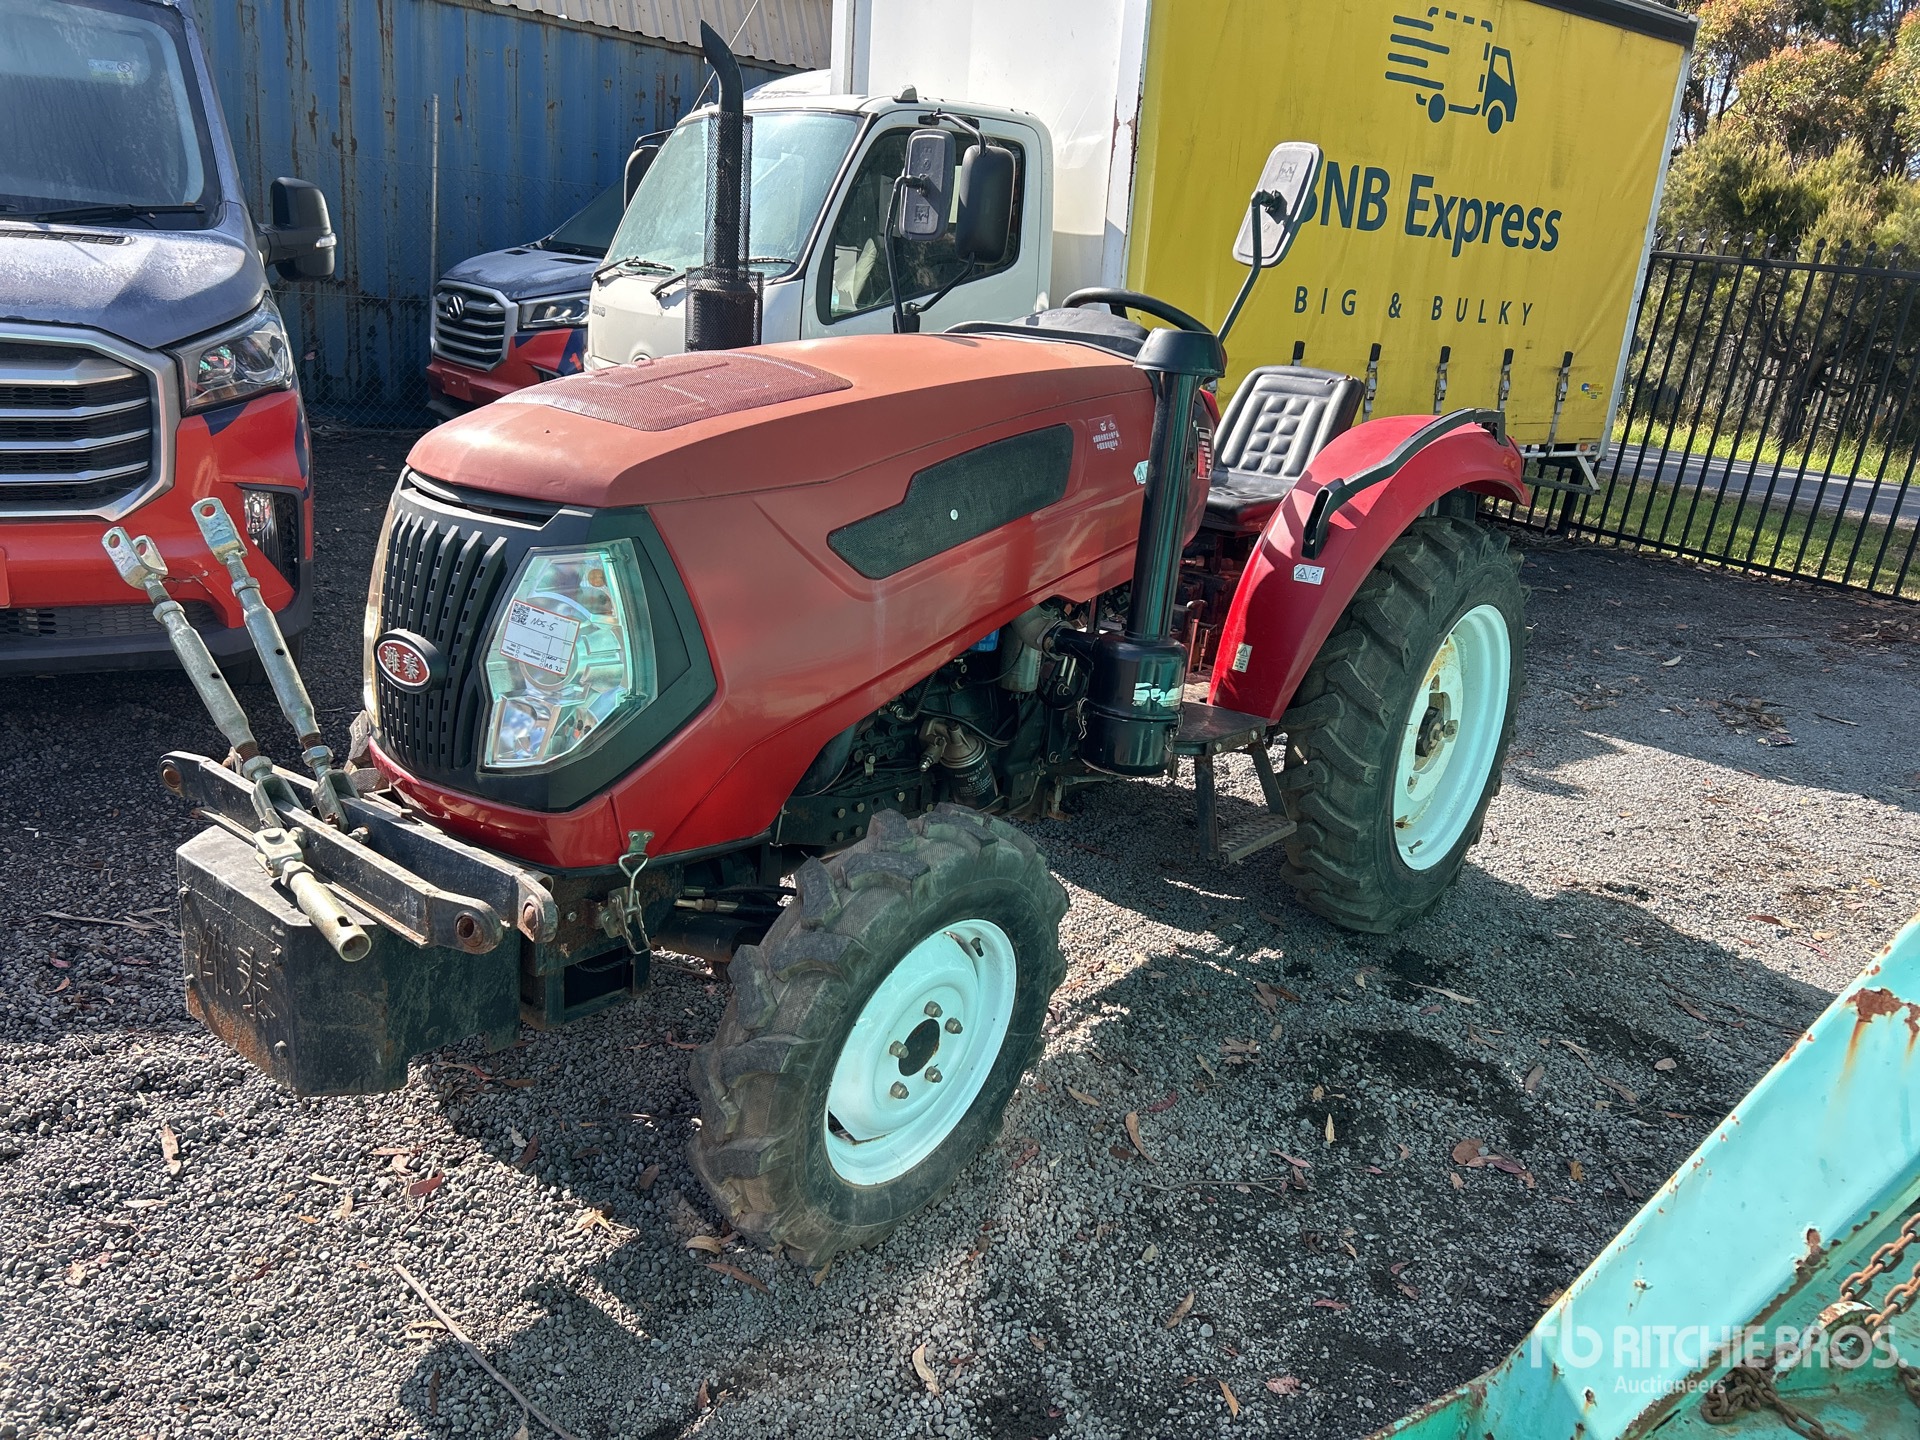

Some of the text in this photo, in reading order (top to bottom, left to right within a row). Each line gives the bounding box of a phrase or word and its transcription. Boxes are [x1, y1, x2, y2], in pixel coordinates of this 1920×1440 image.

[1303, 161, 1563, 258] NB Express
[1294, 286, 1533, 326] BIG & BULKY
